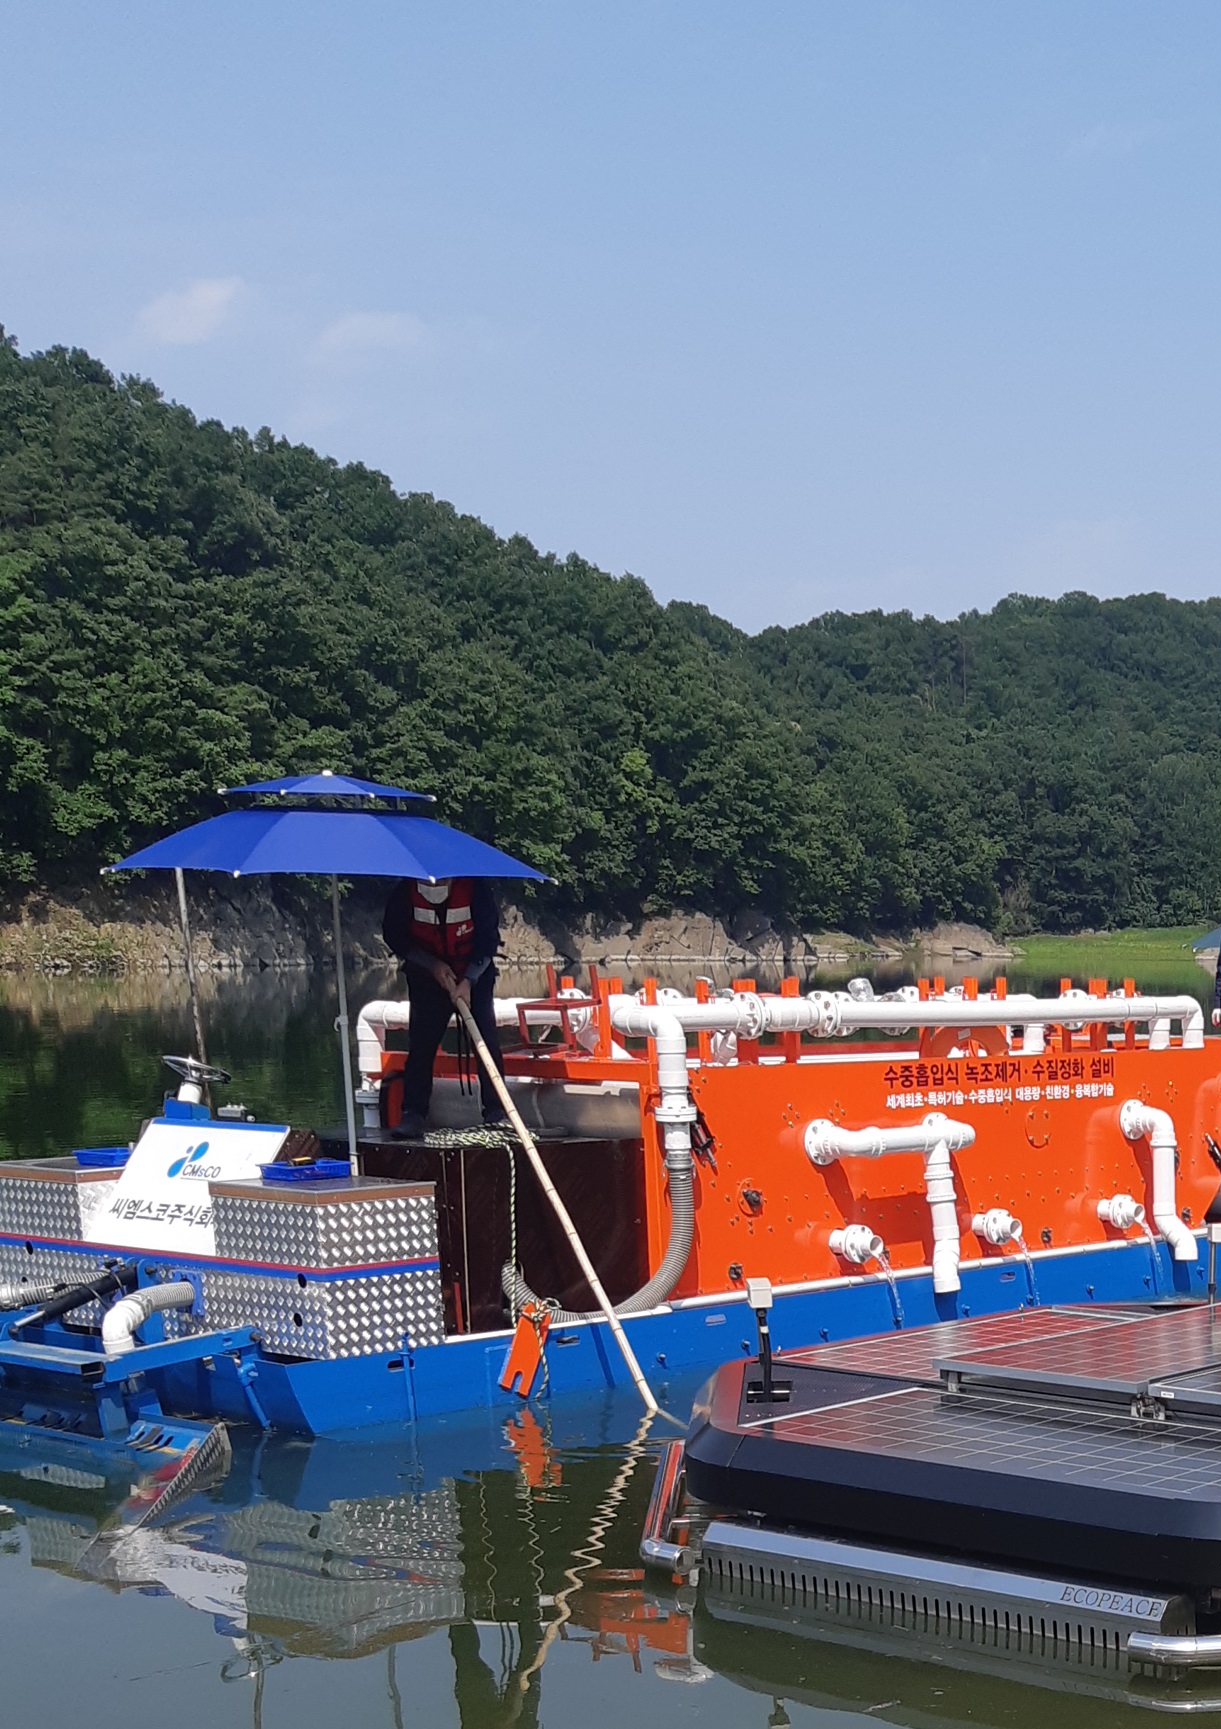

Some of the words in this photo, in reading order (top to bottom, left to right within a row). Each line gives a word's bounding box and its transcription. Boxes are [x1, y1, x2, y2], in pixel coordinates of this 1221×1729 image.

[884, 1062, 959, 1089] 수중흡입식
[1090, 1056, 1114, 1078] 설비
[109, 1198, 214, 1228] 씨엠스코주식회
[1060, 1586, 1162, 1617] ECOPEACE
